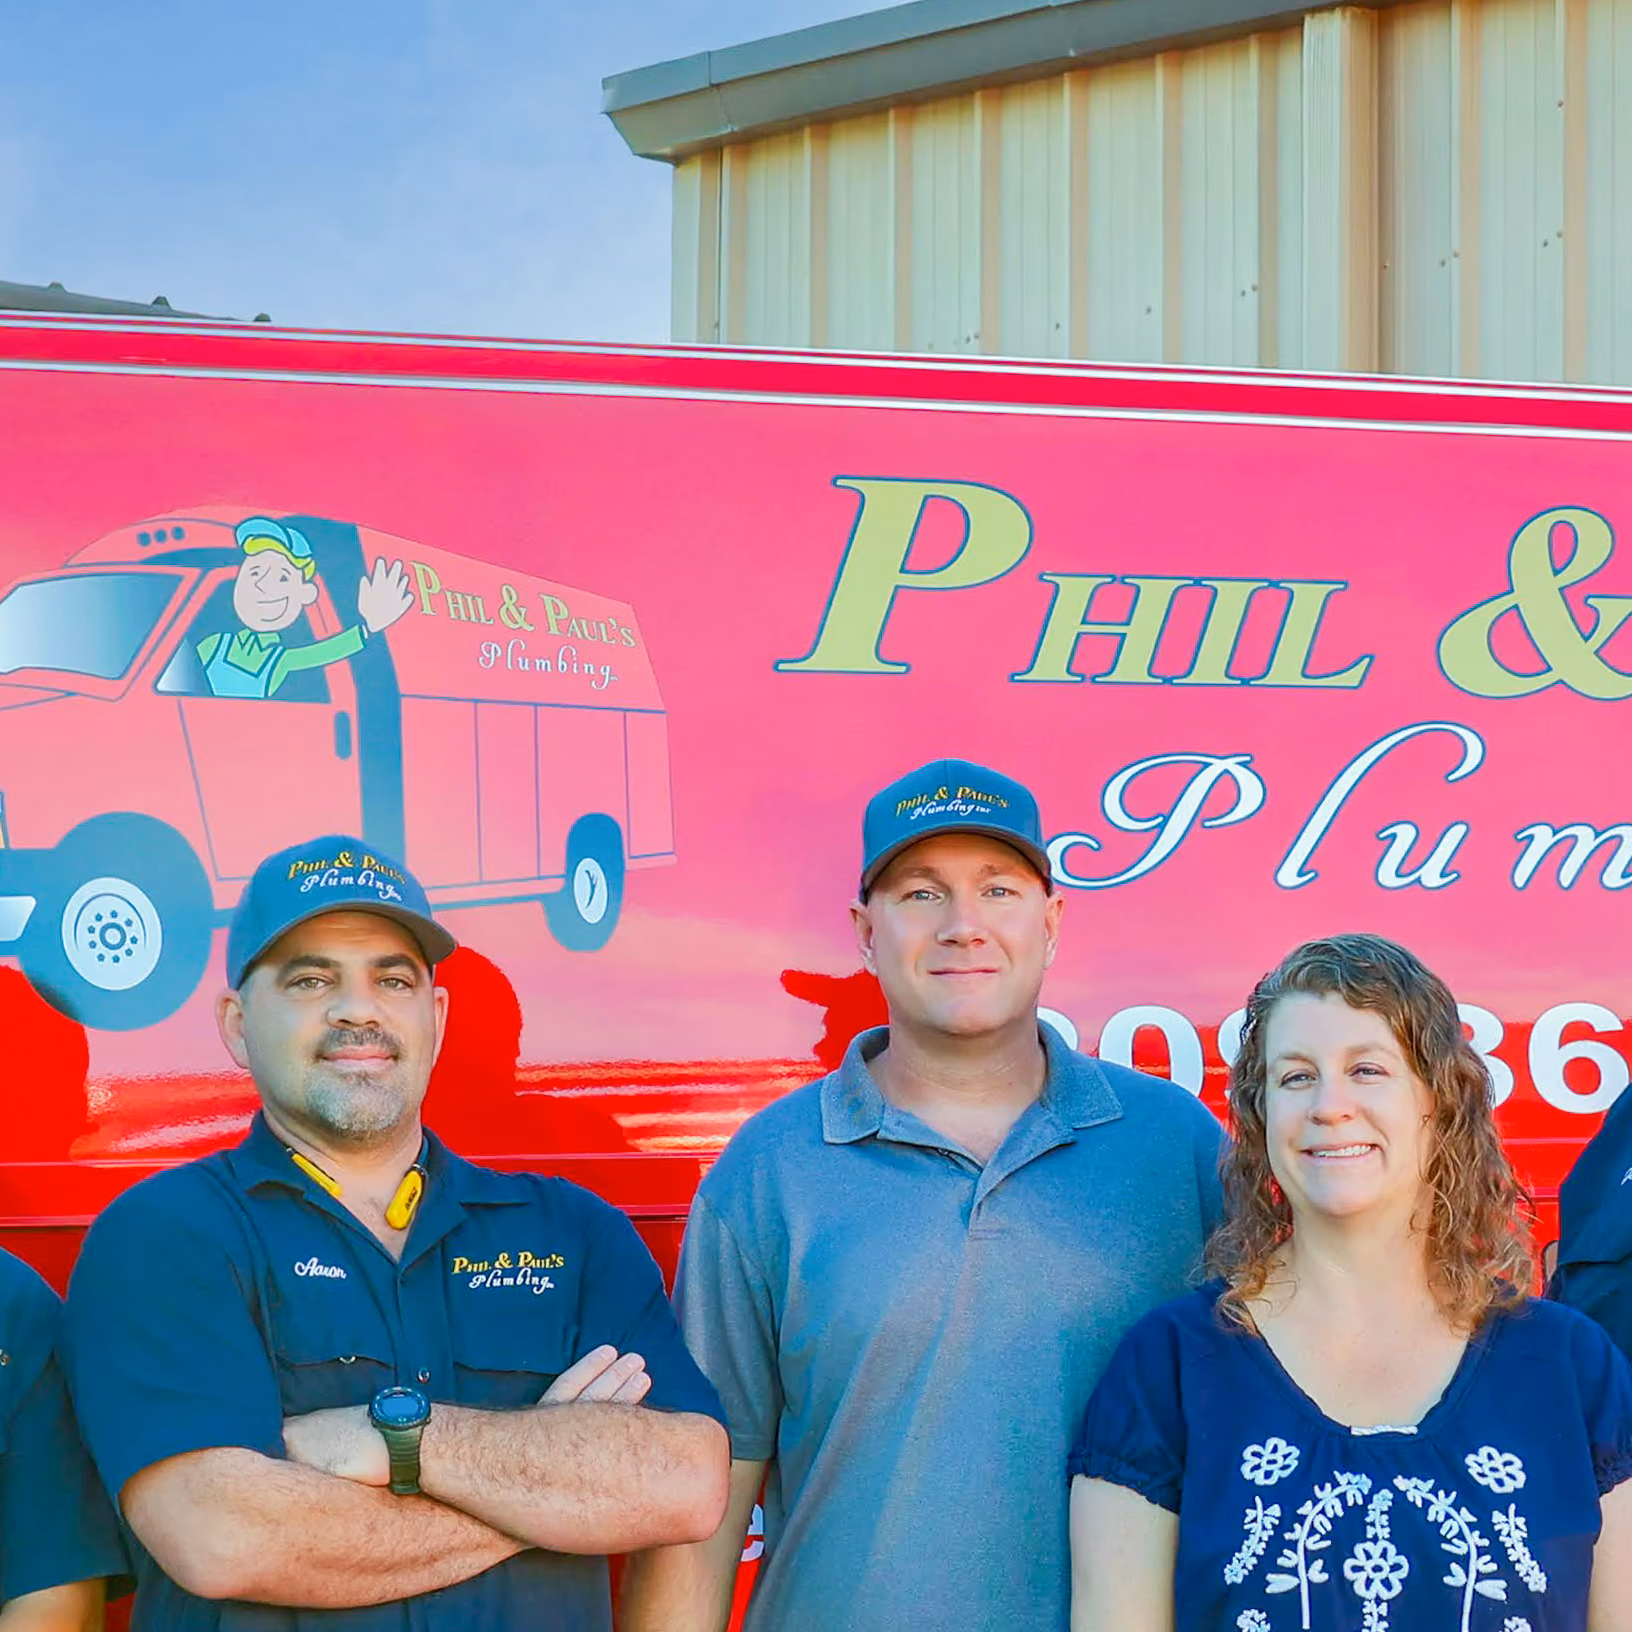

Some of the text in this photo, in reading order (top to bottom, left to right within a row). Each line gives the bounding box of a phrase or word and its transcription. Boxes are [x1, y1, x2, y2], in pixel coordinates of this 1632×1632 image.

[772, 475, 1374, 689] PHIL
[410, 560, 637, 648] PHIL & PAUL'S
[478, 639, 613, 690] Plumbing
[934, 786, 948, 800] &
[910, 799, 975, 819] Plumbing
[333, 851, 353, 867] &
[300, 868, 394, 899] Plumbing
[294, 1257, 347, 1279] Aaron
[494, 1252, 513, 1268] &
[469, 1267, 549, 1294] Plumbing
